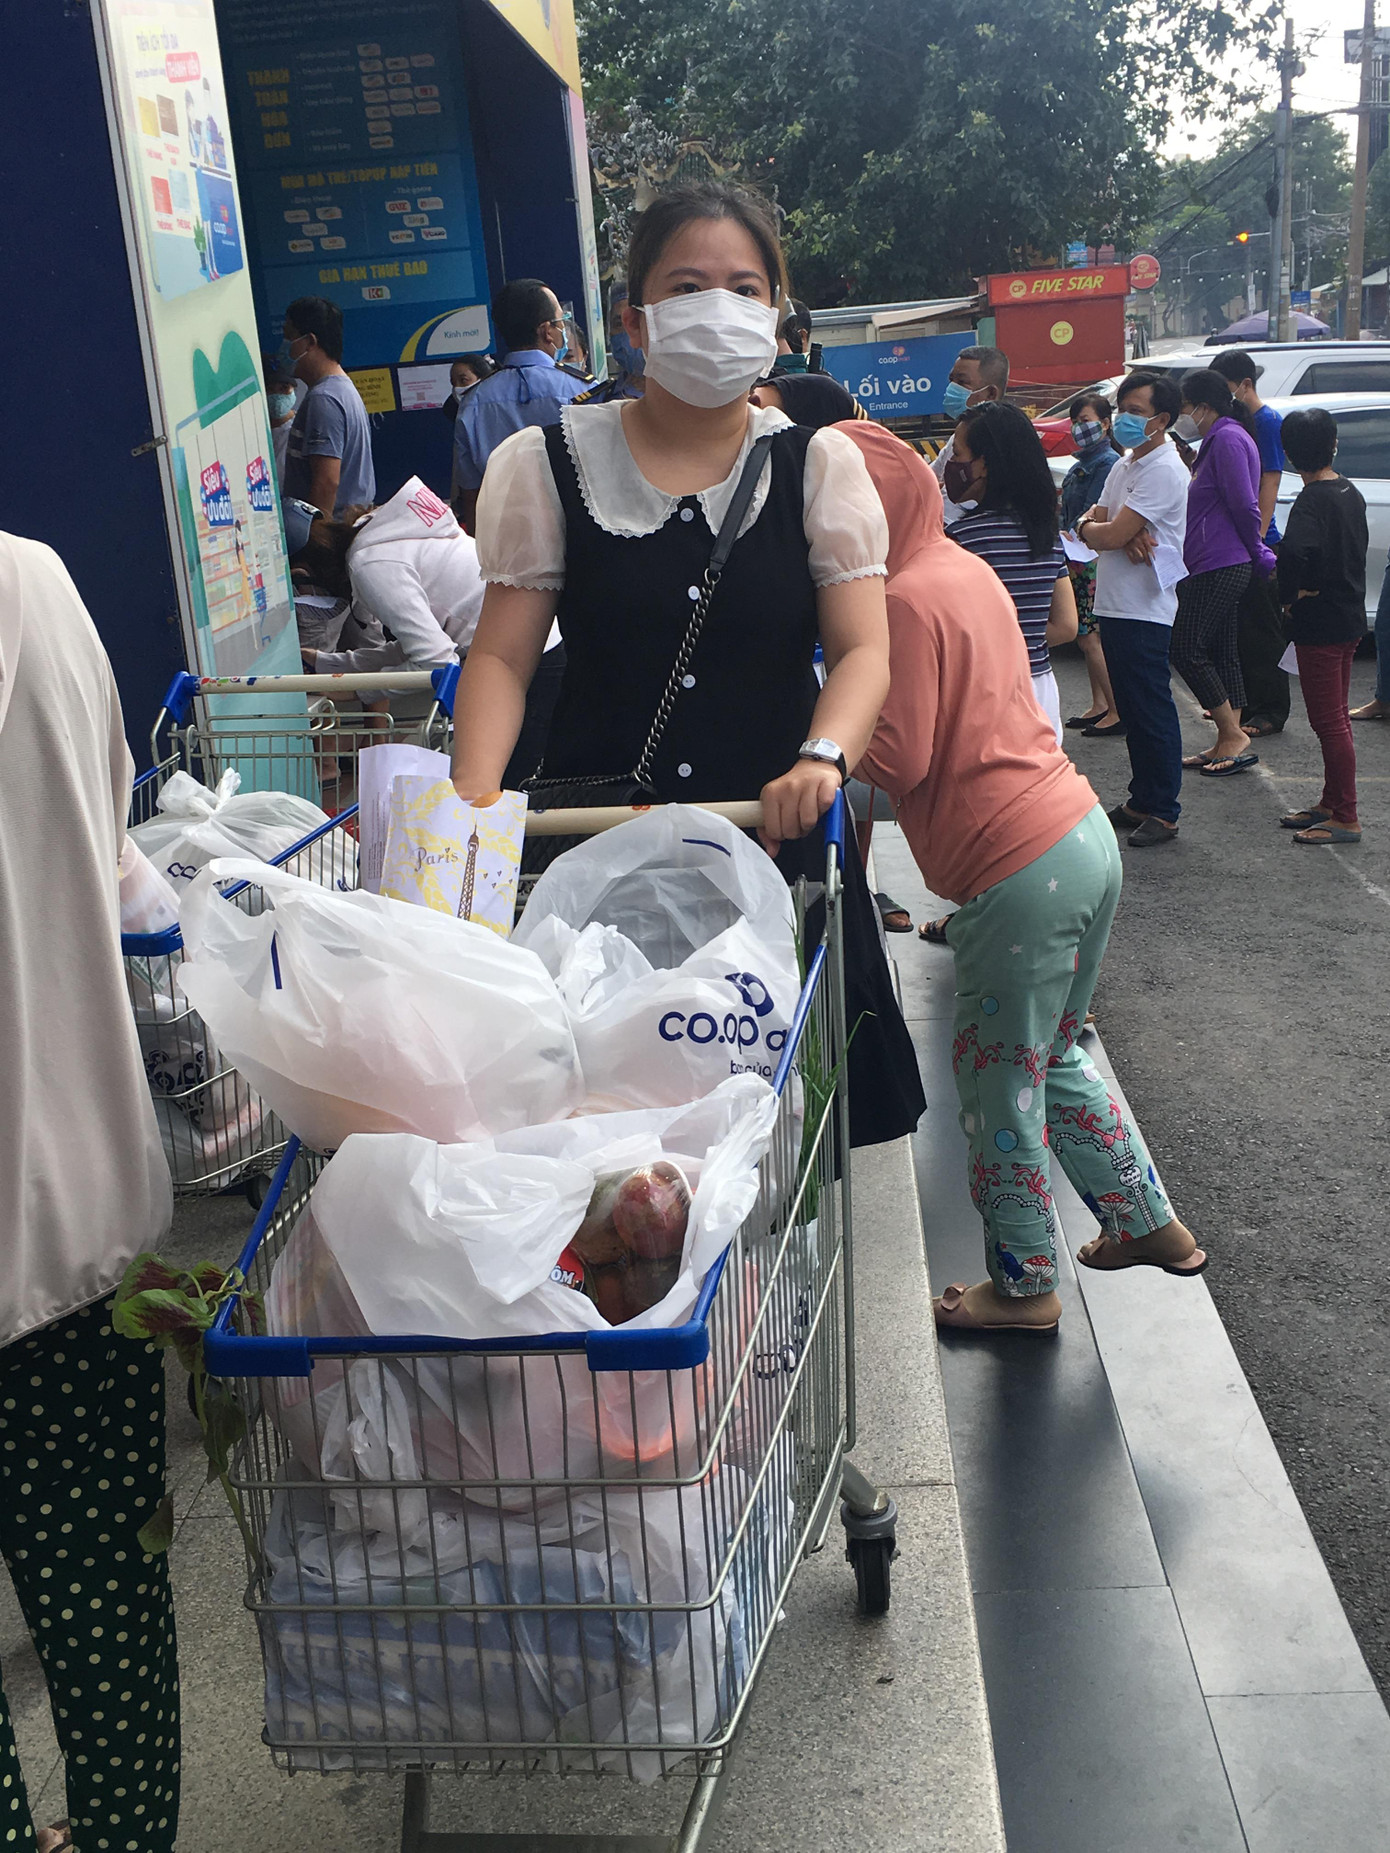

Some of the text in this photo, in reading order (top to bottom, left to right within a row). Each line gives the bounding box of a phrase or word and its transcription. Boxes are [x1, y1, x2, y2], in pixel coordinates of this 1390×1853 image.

[1031, 278, 1065, 294] FIVE
[1067, 275, 1104, 291] STAR
[1053, 328, 1070, 339] CP
[850, 374, 932, 398] ối vào
[869, 401, 909, 411] Entrance
[204, 467, 220, 495] Siêu
[250, 461, 263, 485] Siêu
[414, 846, 459, 872] Paris
[658, 1011, 759, 1055] co.op
